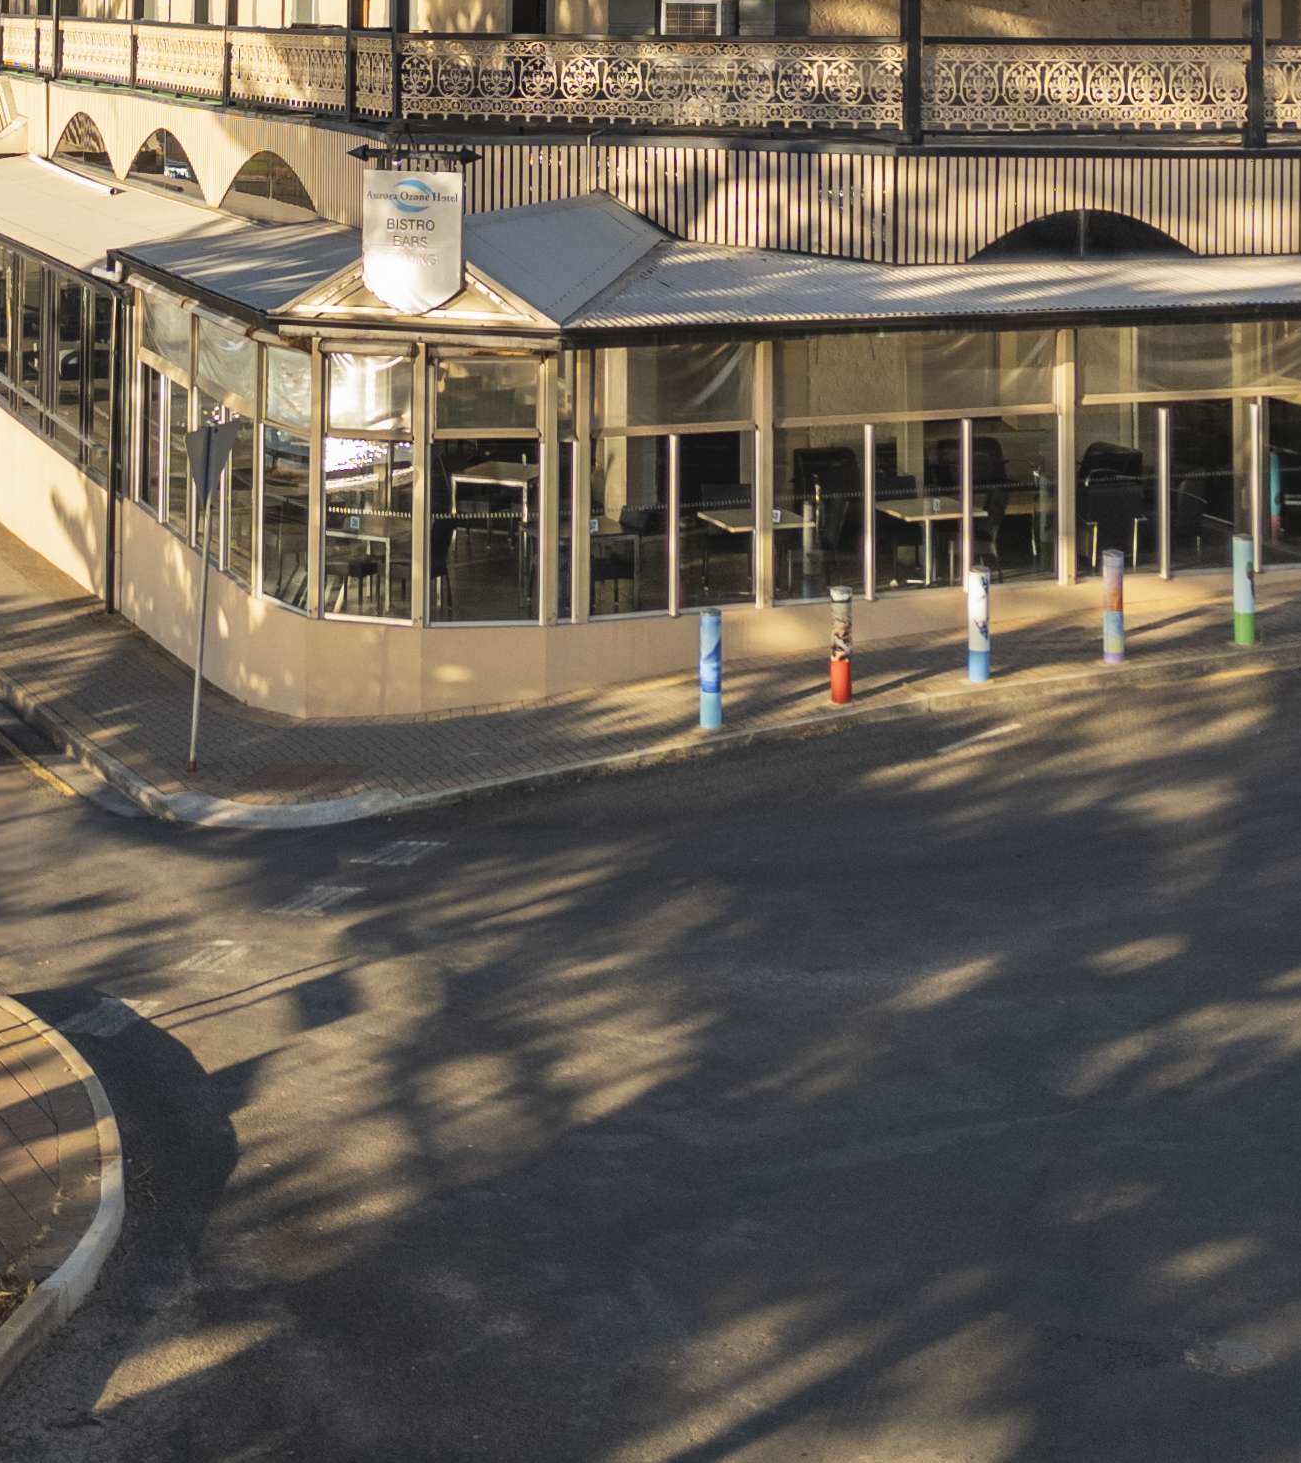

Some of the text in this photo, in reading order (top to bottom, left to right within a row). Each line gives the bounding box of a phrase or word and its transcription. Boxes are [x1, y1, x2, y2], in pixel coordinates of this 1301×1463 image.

[366, 190, 458, 202] Aurora Ozone Hotel
[386, 218, 435, 231] BISTRO
[393, 235, 428, 248] BARS
